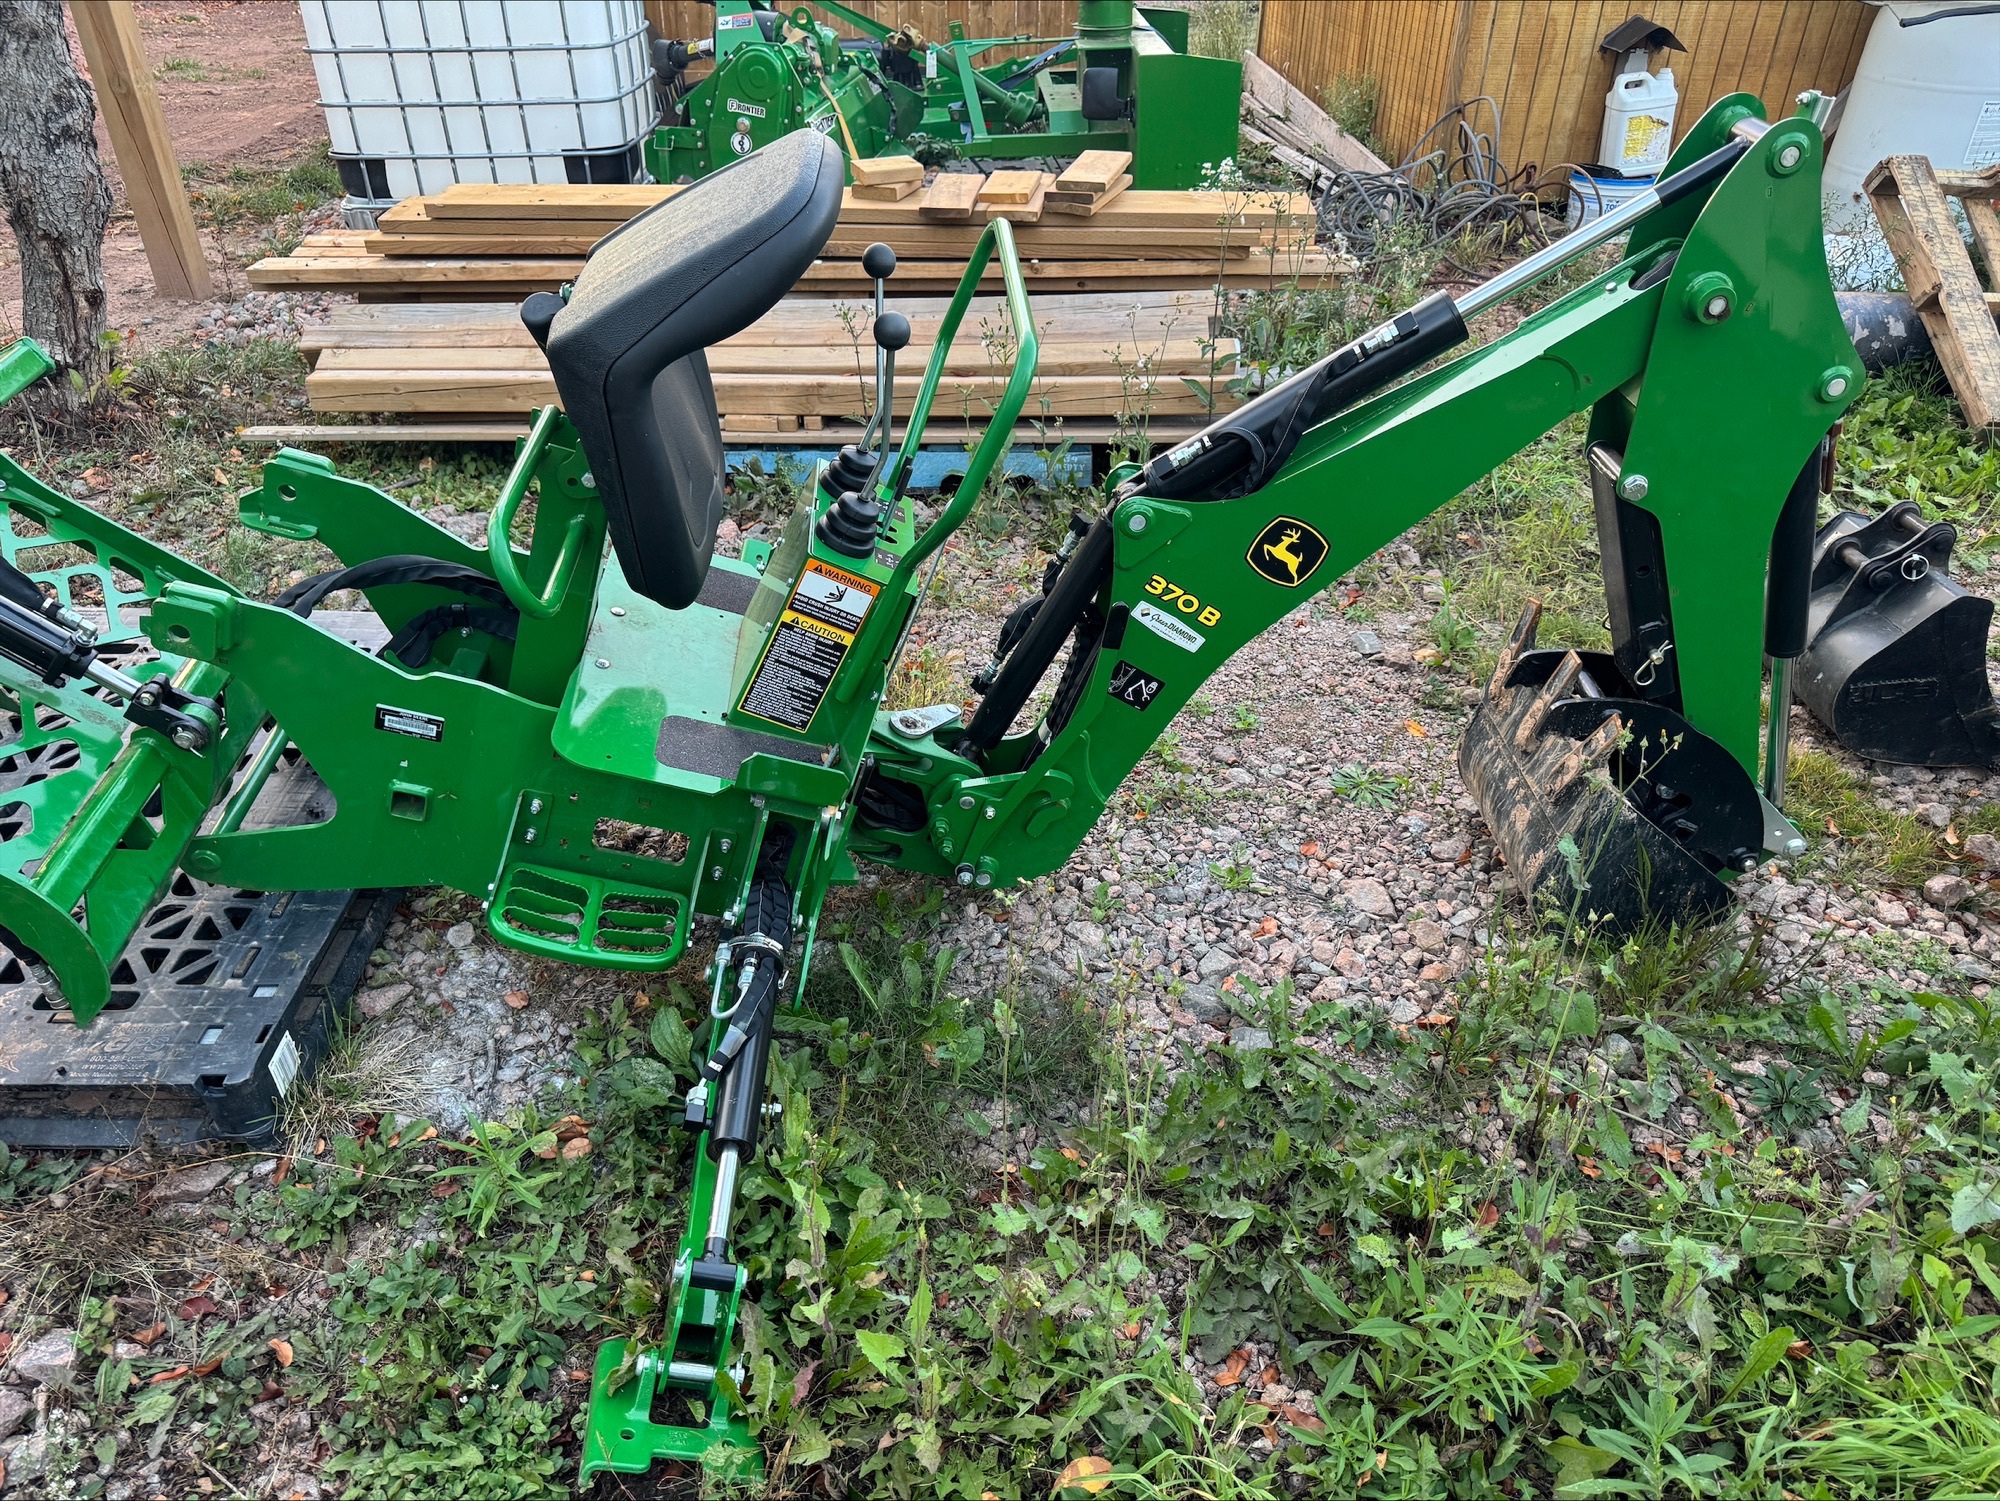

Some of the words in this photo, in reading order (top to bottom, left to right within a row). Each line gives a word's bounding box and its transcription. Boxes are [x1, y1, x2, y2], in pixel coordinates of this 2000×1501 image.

[729, 99, 765, 117] FRONTIER
[824, 567, 872, 593] WARNING
[1143, 573, 1201, 614] 370
[1196, 604, 1222, 628] B
[800, 620, 846, 643] CAUTION
